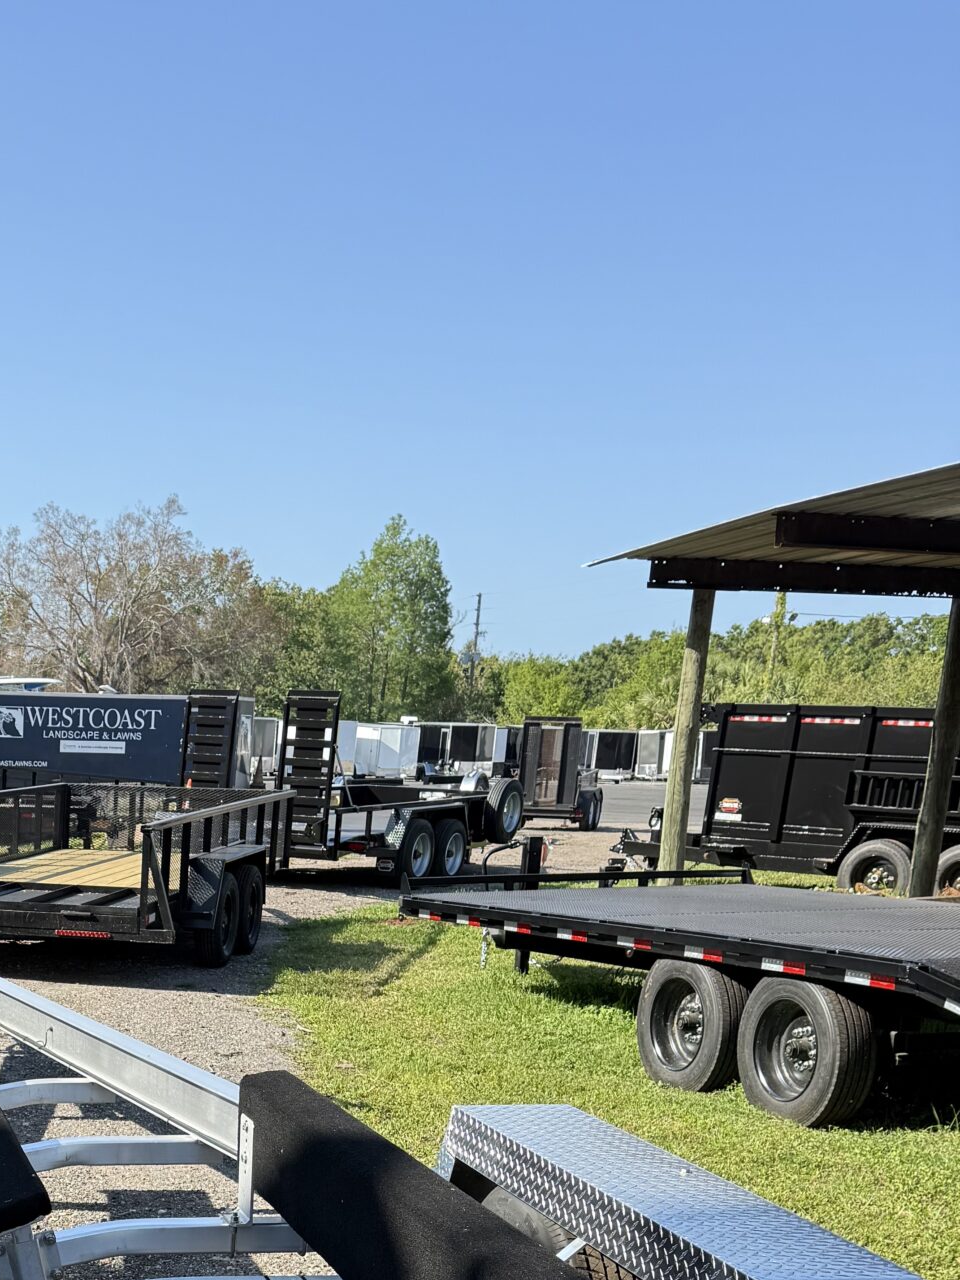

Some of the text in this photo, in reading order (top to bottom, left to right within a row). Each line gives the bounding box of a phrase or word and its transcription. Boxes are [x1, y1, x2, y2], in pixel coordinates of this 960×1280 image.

[26, 706, 162, 730] WESTCOAST
[43, 730, 142, 741] LANDSCAPE & LAWNS
